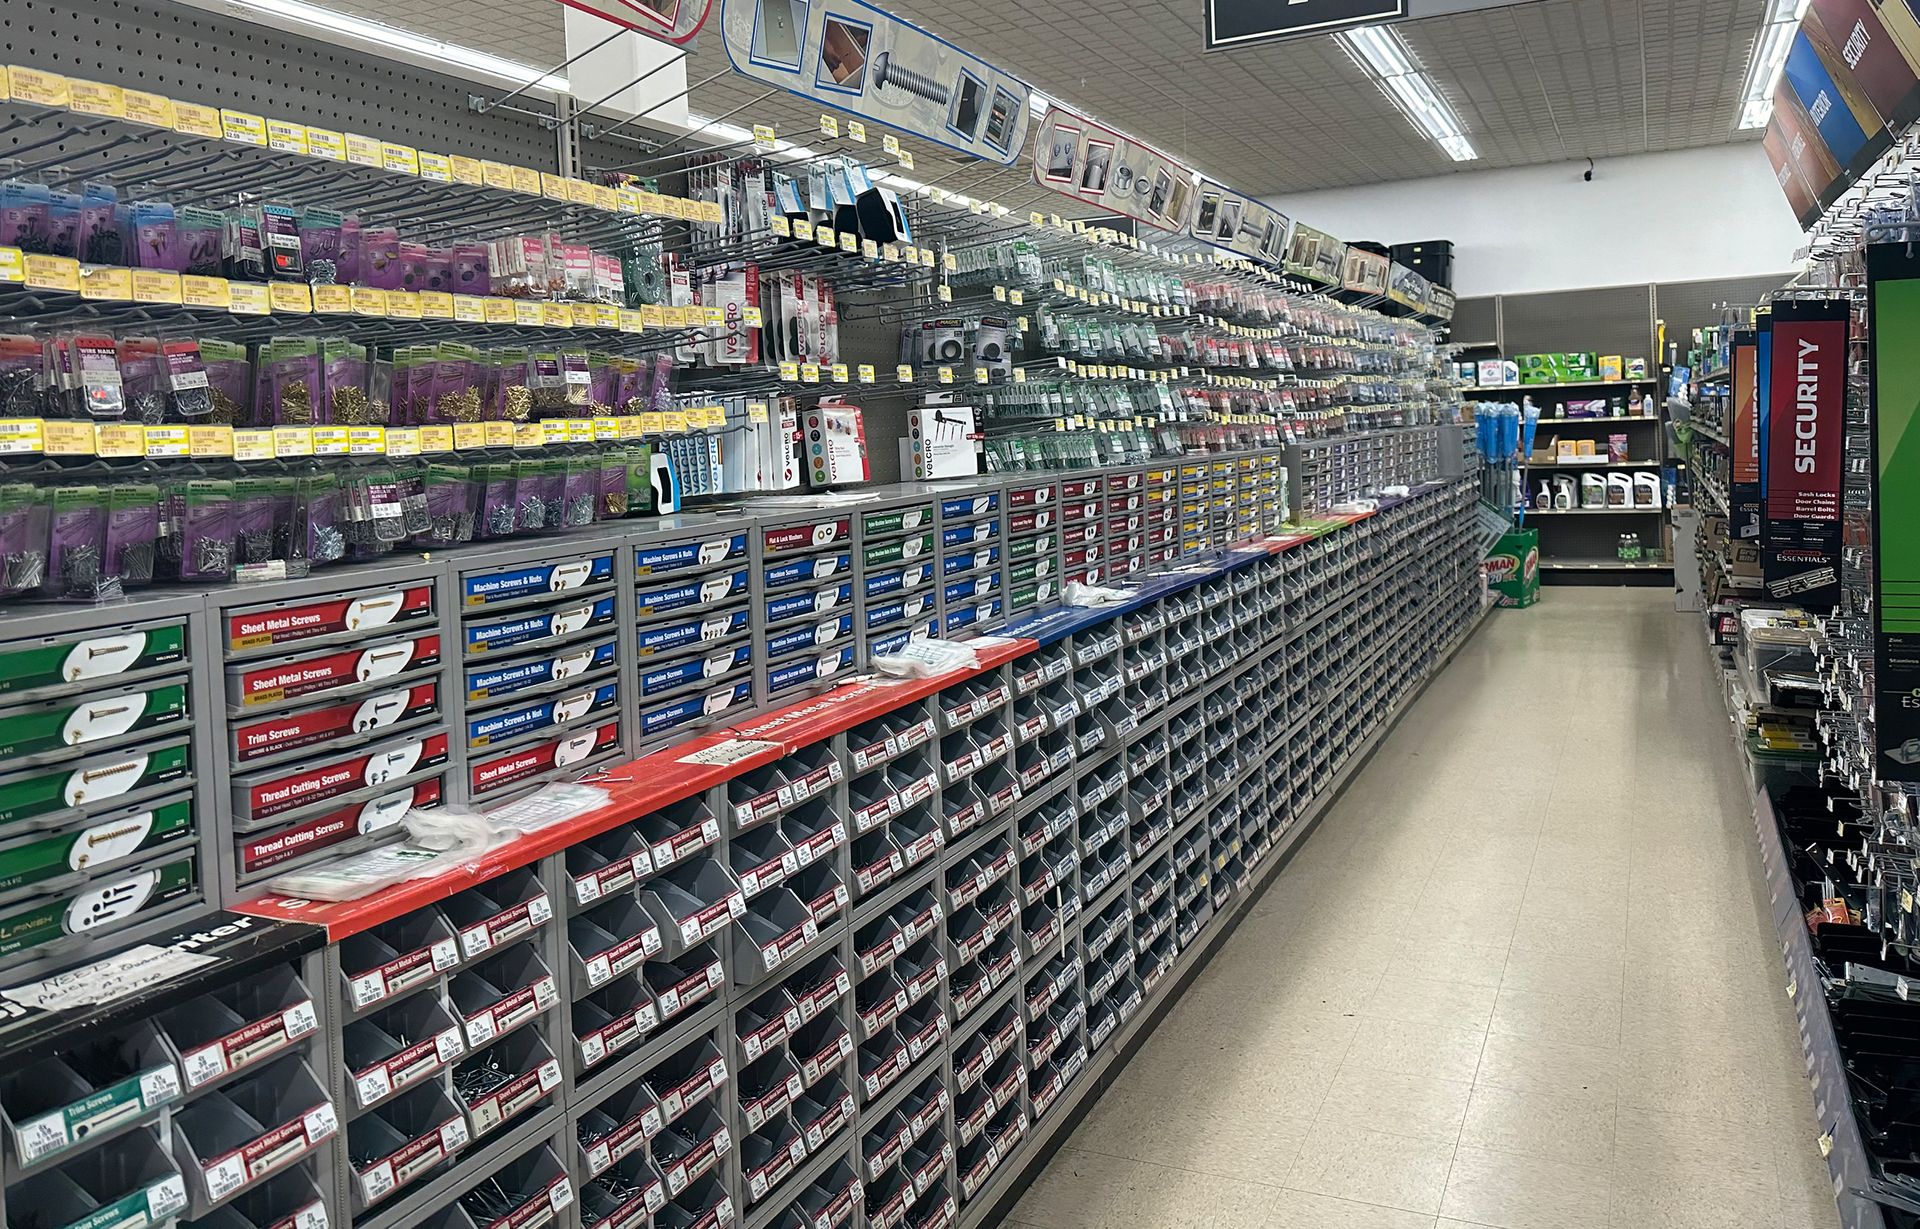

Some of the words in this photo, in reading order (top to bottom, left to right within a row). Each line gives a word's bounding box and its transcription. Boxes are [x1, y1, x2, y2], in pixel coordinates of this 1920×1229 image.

[1843, 18, 1871, 70] SECURITY
[1794, 338, 1819, 473] SECURITY
[700, 437, 708, 493] VELCRO
[710, 435, 718, 491] VELCRO
[925, 438, 933, 477] VELCRO
[643, 556, 661, 564] Machine
[474, 581, 499, 593] Machine
[500, 578, 522, 589] Screws
[523, 576, 528, 585] &
[529, 574, 543, 584] Nuts
[645, 595, 663, 604] Machine
[664, 592, 680, 600] Screws
[772, 605, 786, 613] Machine
[241, 623, 265, 635] Sheet
[267, 619, 290, 630] Metal
[291, 613, 321, 627] Screws
[476, 625, 501, 640] Machine
[502, 622, 524, 635] Screws
[524, 621, 529, 629] &
[530, 619, 544, 629] Nuts
[645, 636, 664, 644] Machine
[664, 632, 680, 640] Screws
[772, 639, 786, 648] Machine
[253, 677, 278, 691] Sheet
[278, 672, 302, 686] Metal
[302, 667, 332, 681] Screws
[476, 672, 502, 687] Machine
[502, 669, 524, 681] Screws
[525, 667, 530, 675] &
[531, 664, 544, 674] Nuts
[648, 675, 666, 684] Machine
[667, 670, 683, 679] Screws
[773, 672, 788, 683] Machine
[788, 669, 799, 677] Screw
[478, 721, 503, 735] Machine
[504, 715, 525, 727] Screws
[526, 712, 531, 721] &
[532, 709, 543, 718] Nut
[648, 713, 666, 724] Machine
[667, 708, 683, 717] Screws
[247, 733, 267, 745] Trim
[269, 726, 300, 740] Screws
[269, 743, 283, 752] BLACK
[480, 768, 498, 781] Sheet
[498, 762, 515, 776] Metal
[515, 756, 537, 770] Screws
[261, 789, 290, 804] Thread
[291, 780, 320, 795] Cutting
[321, 770, 351, 784] Screws
[254, 842, 283, 857] Thread
[284, 831, 314, 847] Cutting
[315, 820, 344, 836] Screws
[489, 916, 501, 928] Sheet
[501, 911, 512, 923] Metal
[512, 906, 527, 919] Screws
[384, 962, 399, 975] Sheet
[399, 956, 414, 970] Metal
[415, 950, 430, 964] Screws
[41, 962, 111, 991] NEED
[494, 1001, 507, 1015] Sheet
[507, 996, 518, 1009] Metal
[518, 990, 532, 1004] Screws
[226, 1033, 244, 1047] Sheet
[244, 1025, 260, 1039] Metal
[260, 1016, 282, 1031] Screws
[389, 1056, 404, 1070] Sheet
[404, 1049, 417, 1063] Metal
[417, 1041, 435, 1056] Screws
[512, 1080, 524, 1092] Metal
[523, 1073, 537, 1086] Screws
[68, 1104, 86, 1116] Trim
[87, 1093, 113, 1110] Screws
[246, 1142, 263, 1156] Sheet
[264, 1132, 280, 1146] Metal
[280, 1122, 301, 1137] Screws
[408, 1143, 421, 1156] Metal
[421, 1133, 438, 1149] Screws
[535, 1194, 549, 1209] Screws
[93, 1208, 120, 1225] Screws
